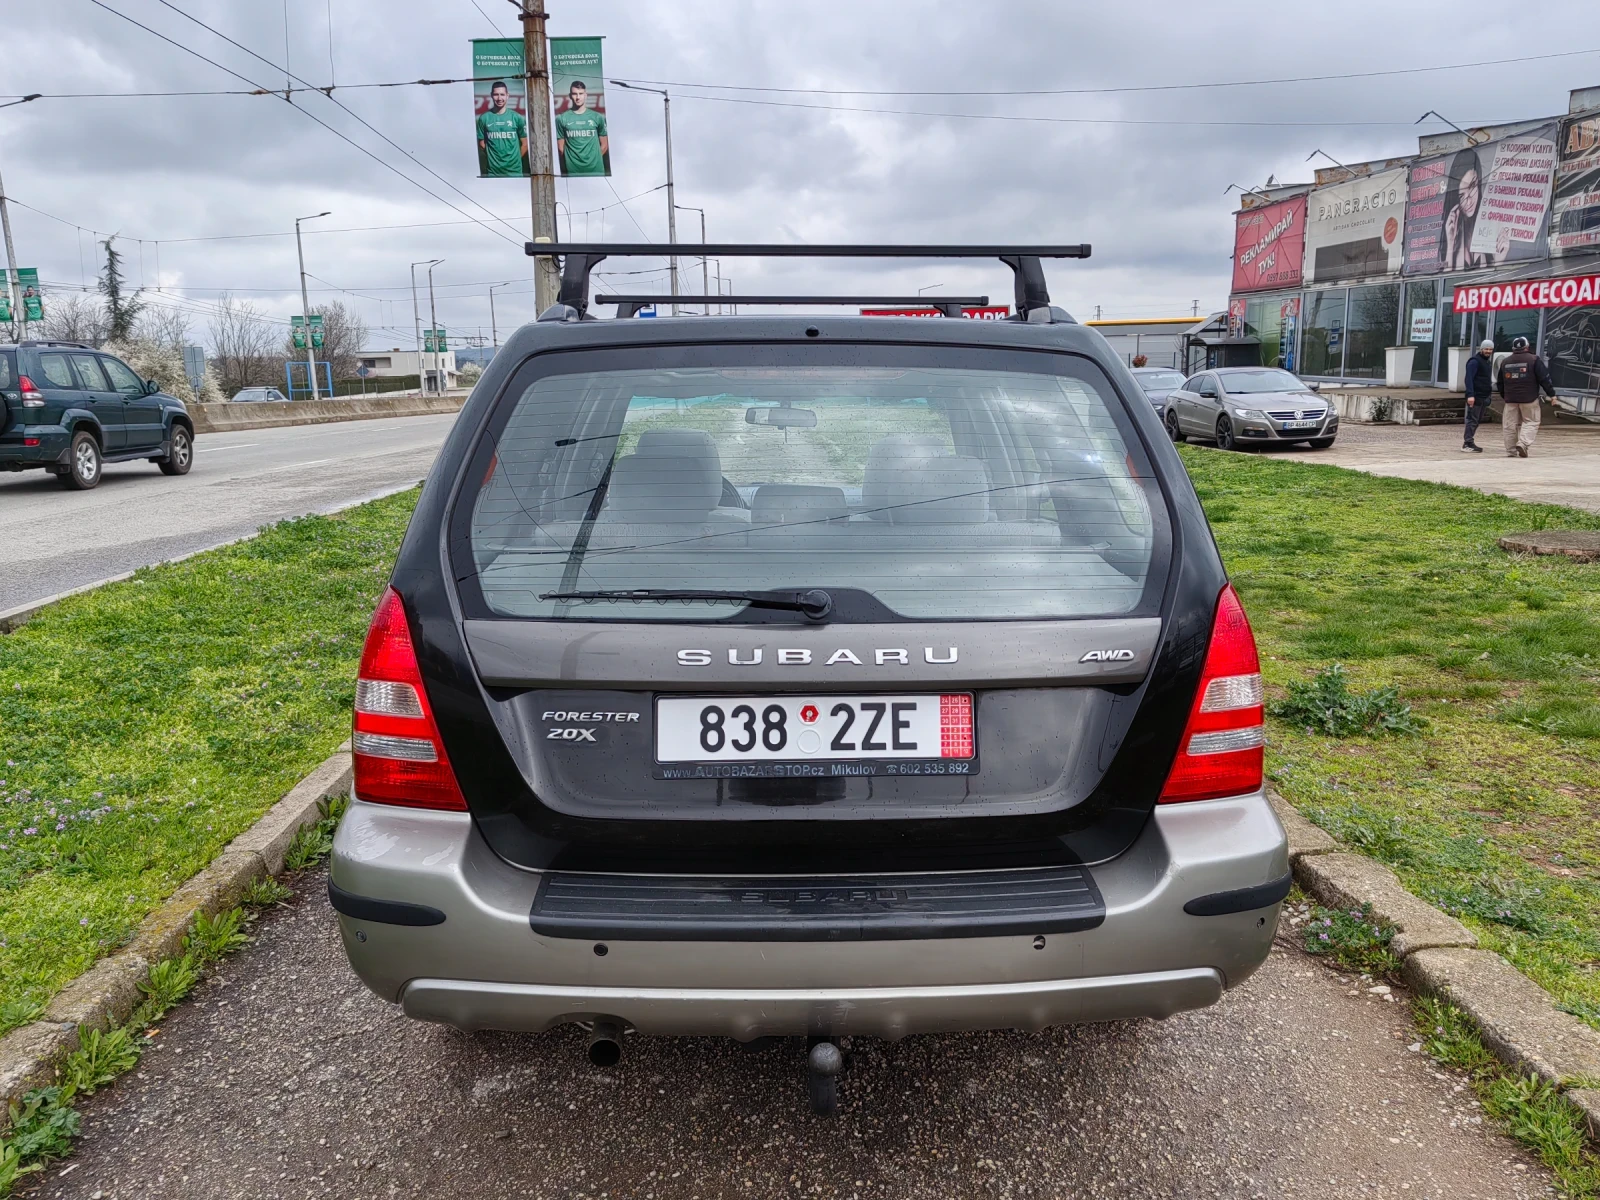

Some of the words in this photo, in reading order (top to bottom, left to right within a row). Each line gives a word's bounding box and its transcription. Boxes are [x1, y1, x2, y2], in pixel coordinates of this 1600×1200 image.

[486, 131, 516, 139] WINBET
[566, 130, 596, 138] WINBET
[1565, 117, 1600, 154] АВ
[1522, 173, 1549, 184] РЕКЛАМА
[1517, 187, 1544, 198] РЕКЛАМА
[1318, 188, 1396, 221] PANCRACIO
[1350, 218, 1376, 228] CHOCOLATE
[1514, 214, 1536, 226] ПЕЧАТИ
[1240, 208, 1293, 268] РЕКЛАМИРАЙ
[1510, 228, 1534, 240] ТЕНИСКИ
[1258, 252, 1275, 276] ТУК!
[677, 647, 958, 666] SUBARU
[1079, 649, 1134, 662] AWD
[542, 711, 640, 722] FORESTER
[700, 704, 787, 752] 838
[830, 702, 918, 750] 2ZE
[831, 764, 877, 775] Mikulov
[900, 764, 921, 774] 602
[924, 764, 945, 774] 535
[948, 763, 969, 773] 892
